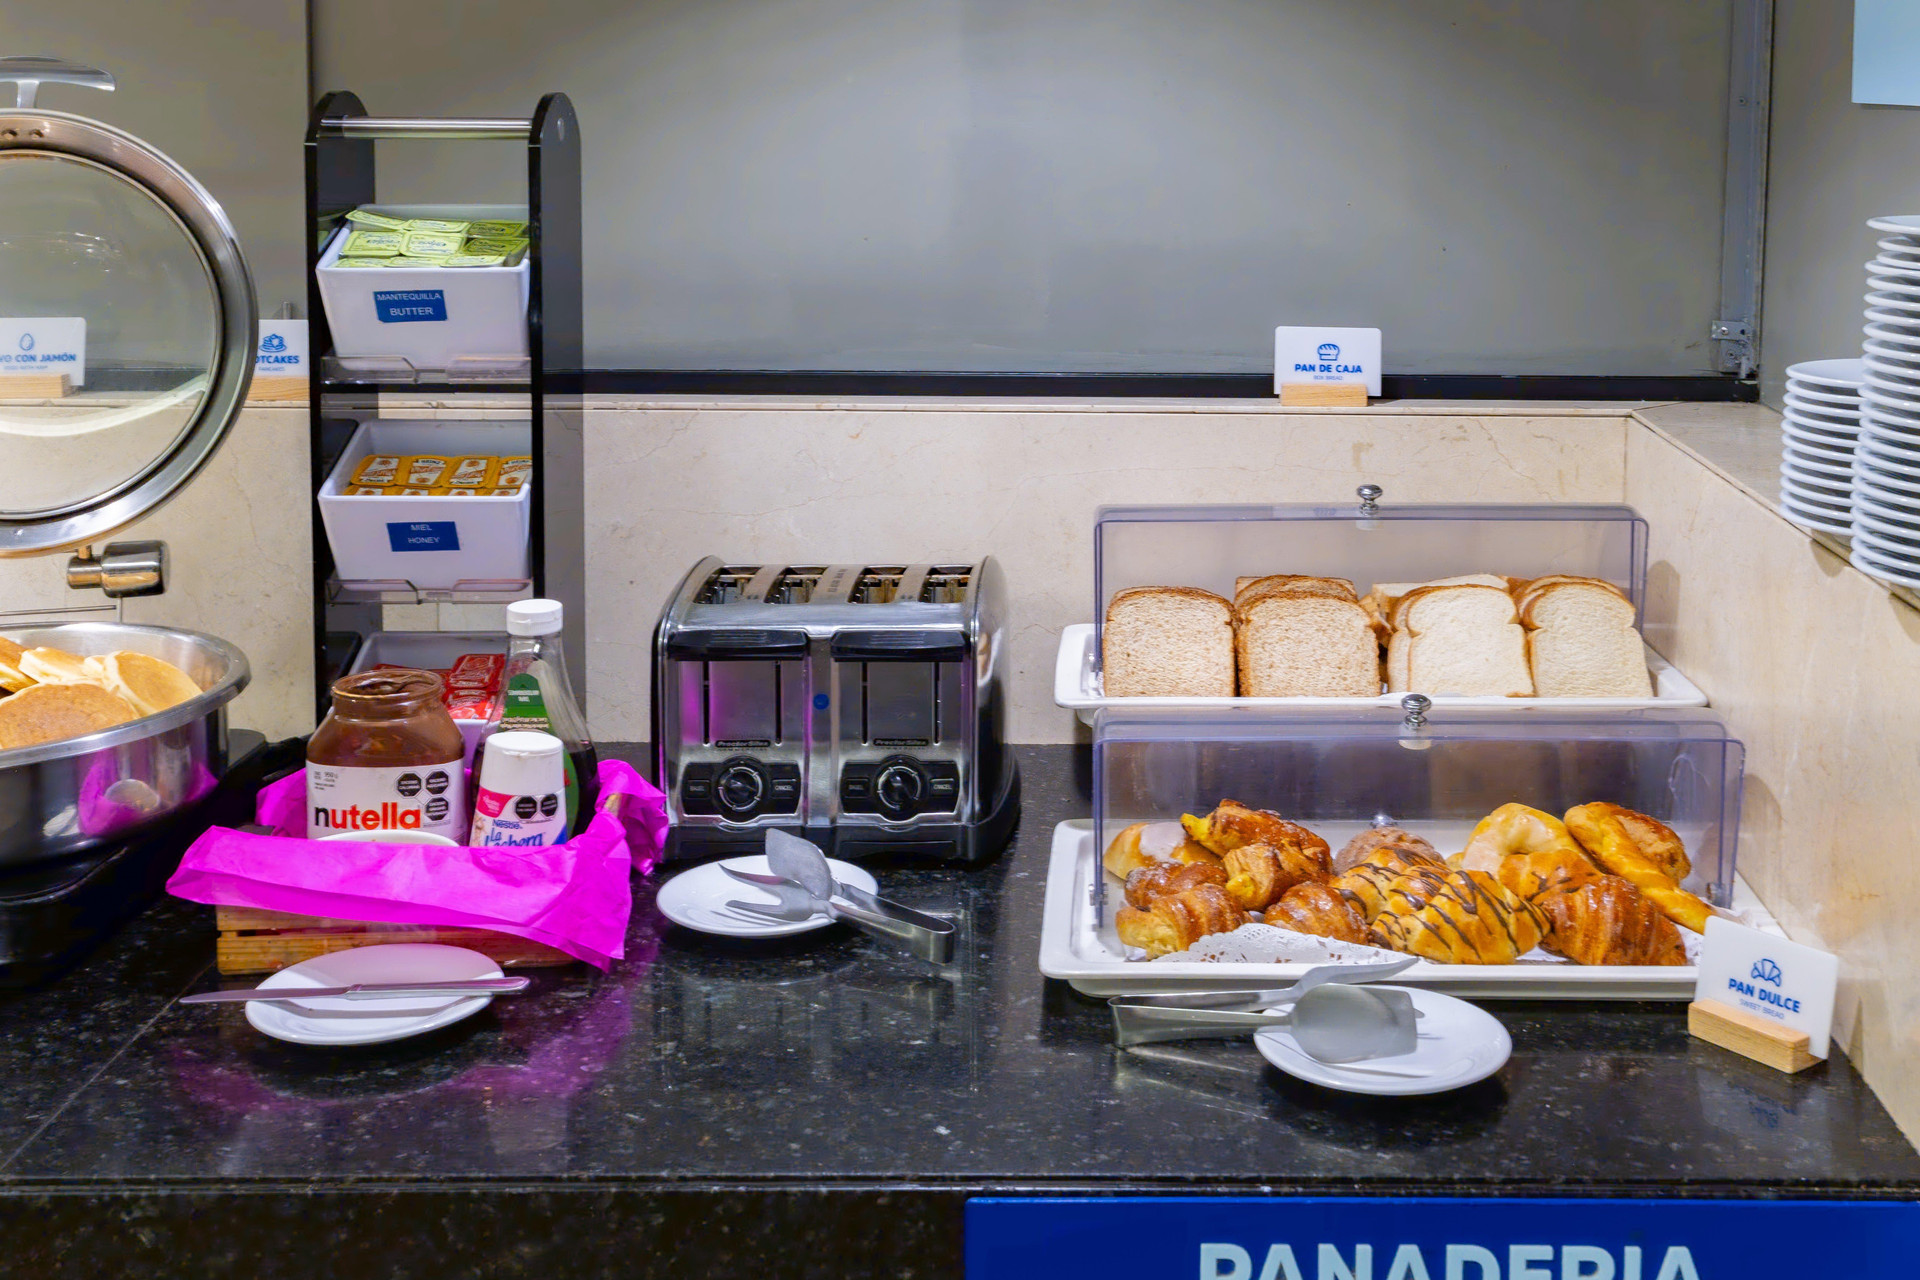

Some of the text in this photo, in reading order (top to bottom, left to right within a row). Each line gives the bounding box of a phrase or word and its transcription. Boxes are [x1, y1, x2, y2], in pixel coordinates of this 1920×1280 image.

[376, 293, 442, 301] MANTEQUILLA
[389, 307, 434, 316] BUTTER
[15, 354, 37, 363] CON
[40, 352, 76, 362] JAMÓN
[1295, 363, 1363, 373] PAN DE CAJA
[407, 536, 440, 544] HONEY
[315, 802, 421, 830] nutella
[491, 827, 502, 841] La
[1728, 978, 1801, 1014] PAN DULCE
